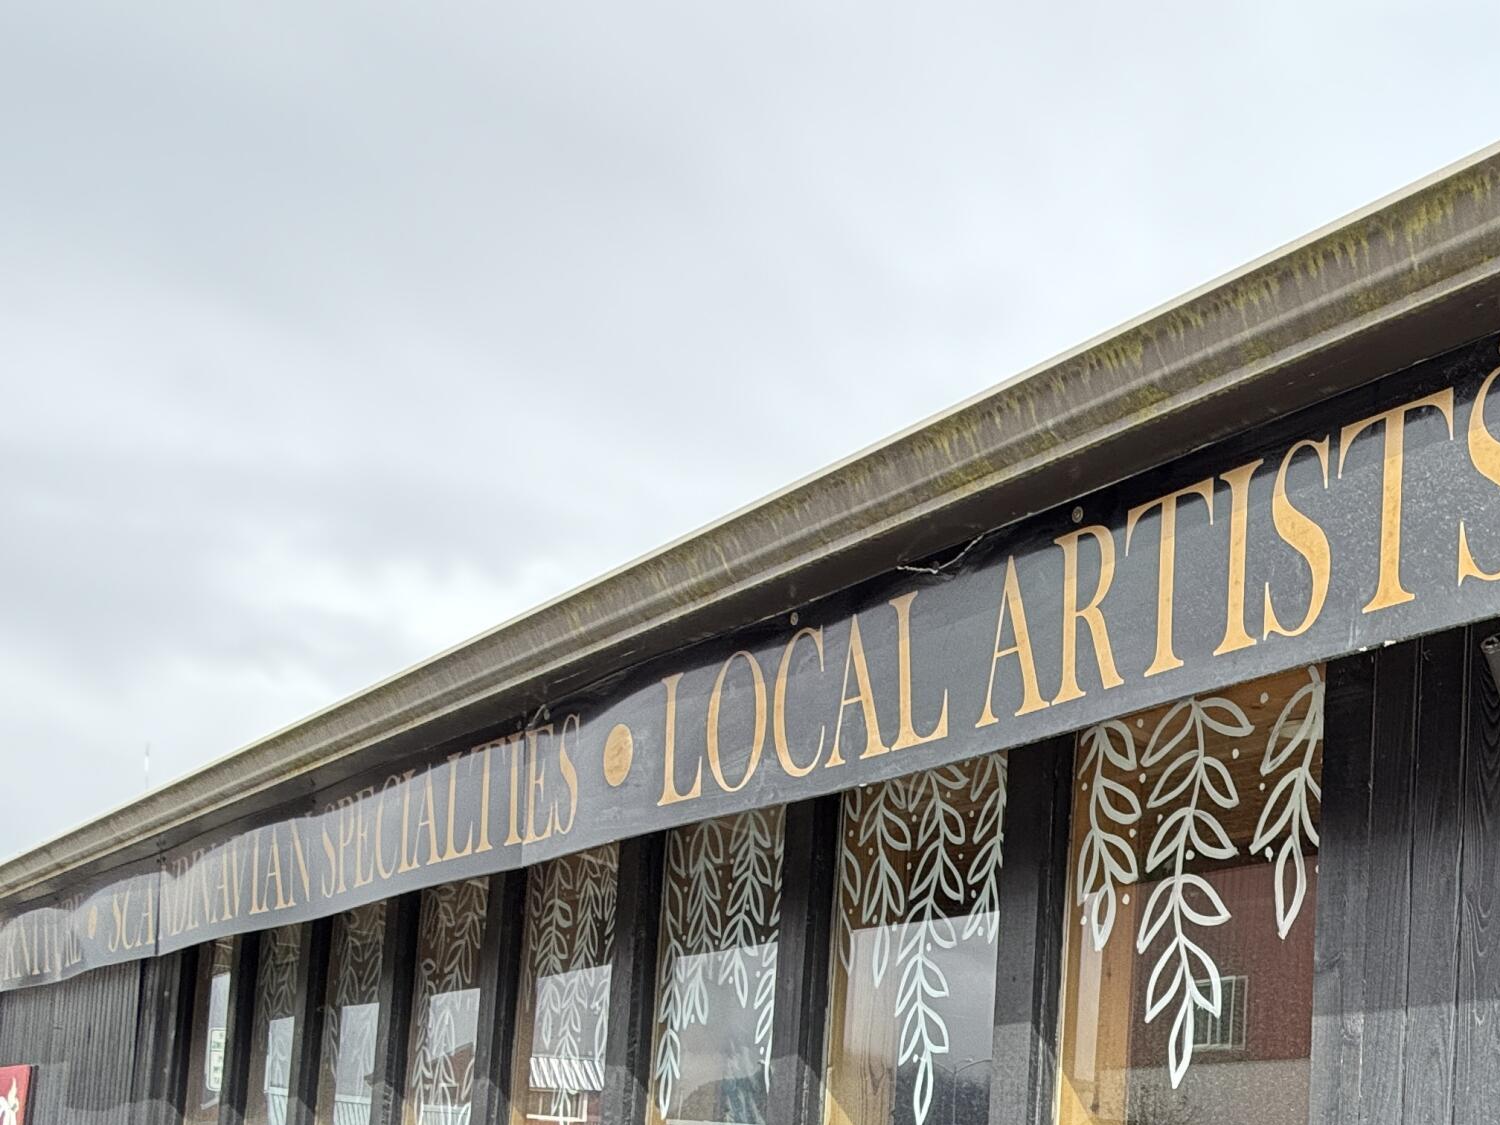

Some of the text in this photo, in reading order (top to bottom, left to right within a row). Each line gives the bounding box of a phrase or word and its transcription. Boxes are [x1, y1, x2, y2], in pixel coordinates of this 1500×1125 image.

[0, 893, 82, 982] RNITURE
[321, 712, 581, 899] SPECIALTIES
[656, 590, 949, 807] LOCAL
